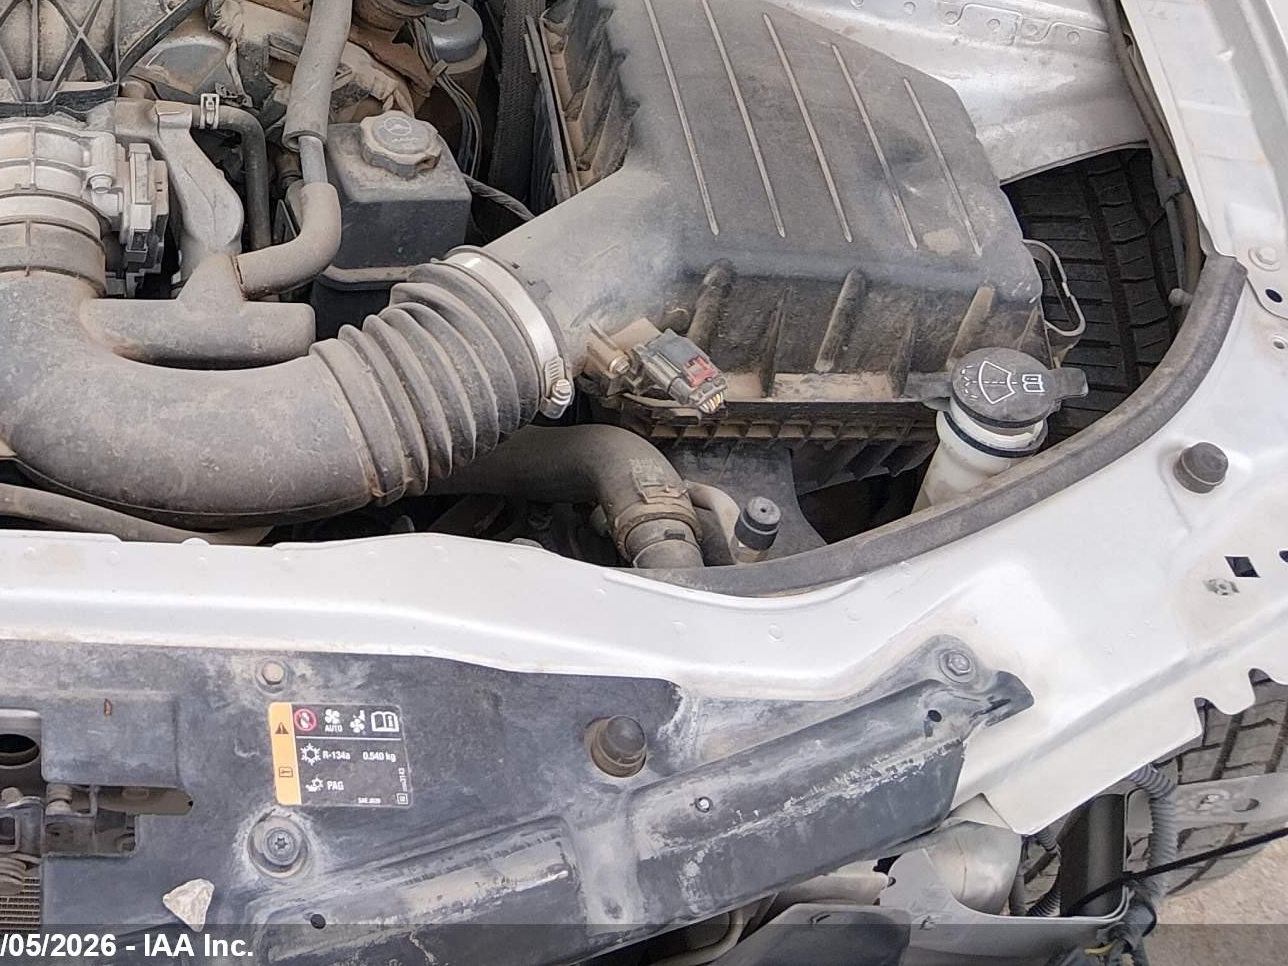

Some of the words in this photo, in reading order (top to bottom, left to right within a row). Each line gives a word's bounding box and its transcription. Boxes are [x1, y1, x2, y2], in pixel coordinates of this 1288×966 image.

[324, 724, 343, 733] AUTO
[322, 751, 351, 760] R-134a
[385, 752, 397, 763] kg
[326, 780, 344, 791] PAG
